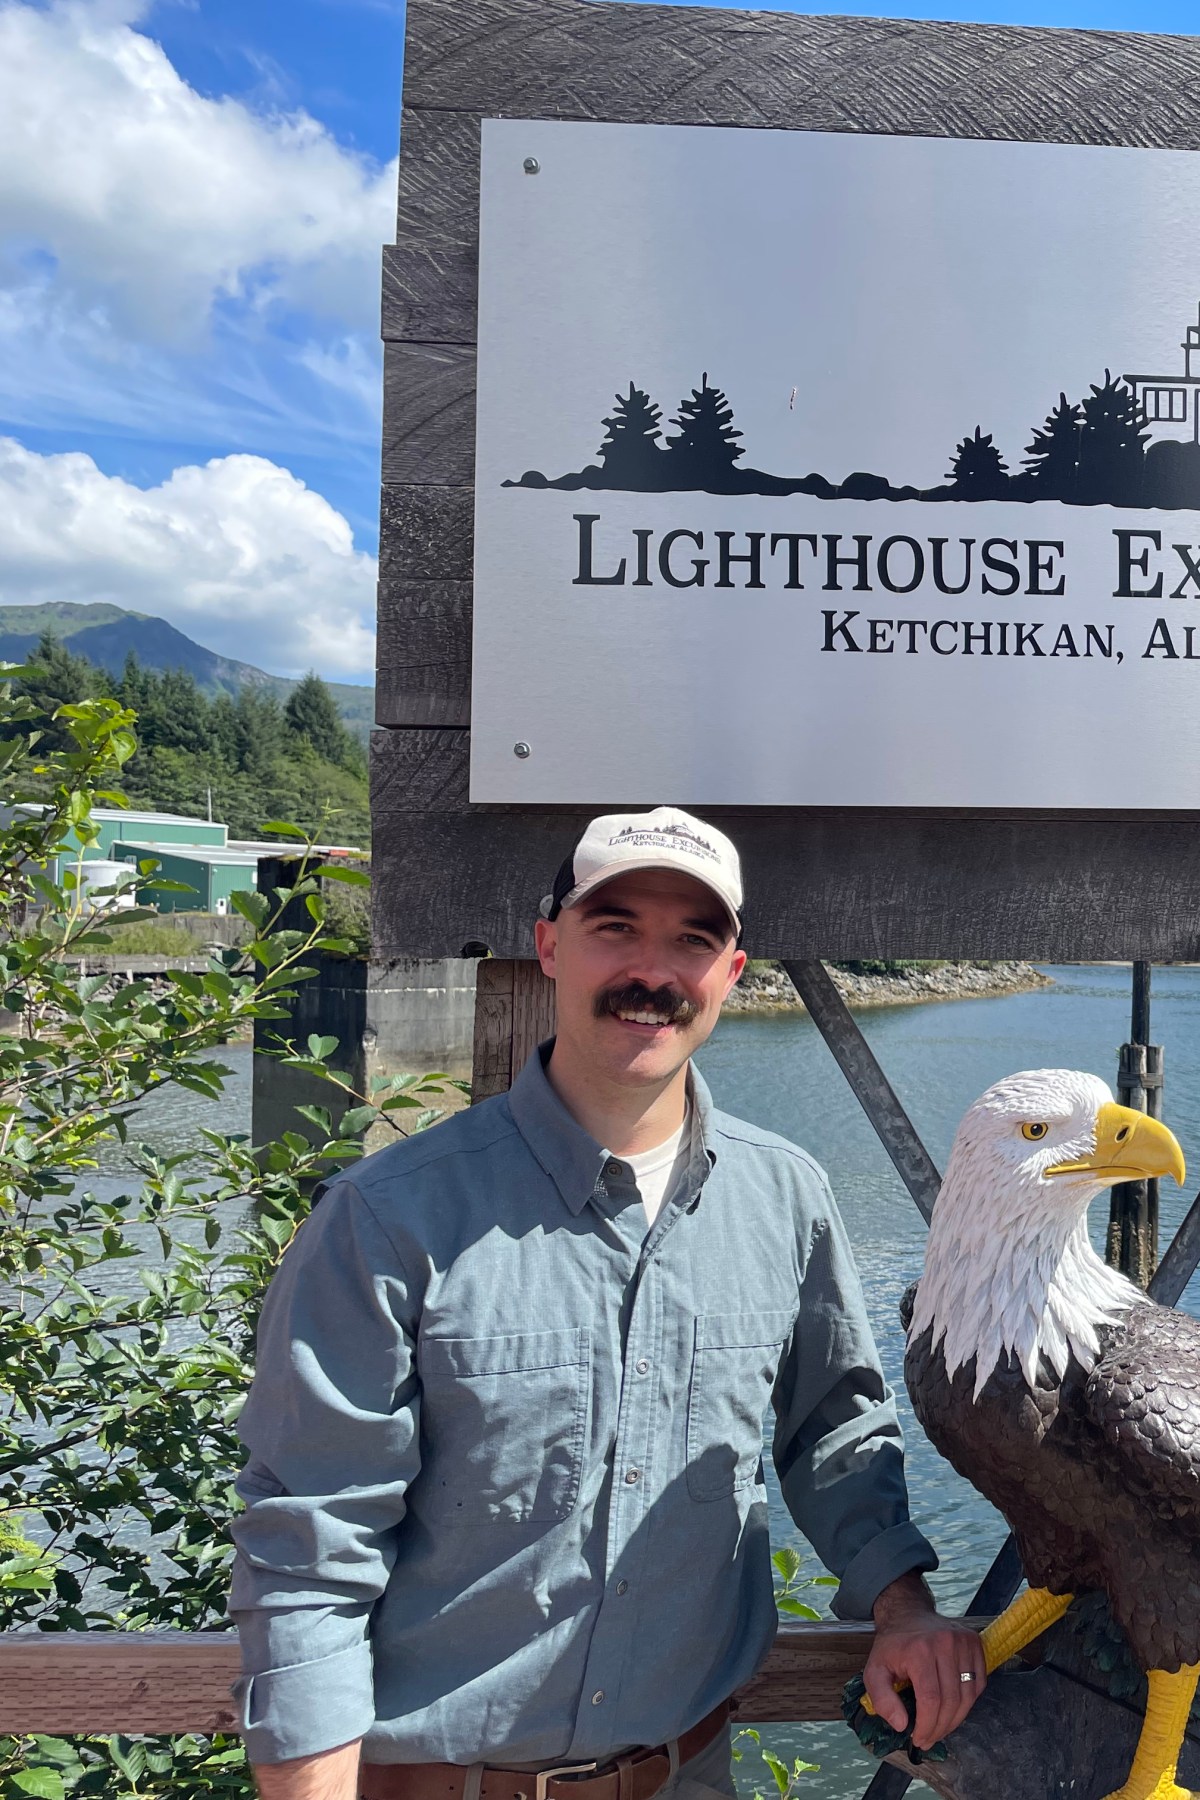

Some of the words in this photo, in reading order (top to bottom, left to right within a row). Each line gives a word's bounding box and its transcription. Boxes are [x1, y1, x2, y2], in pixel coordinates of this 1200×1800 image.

[571, 513, 1066, 597] LIGHTHOUSE
[820, 609, 1124, 665] KETCHIKAN,
[608, 834, 667, 846] LIGHTHOUSE
